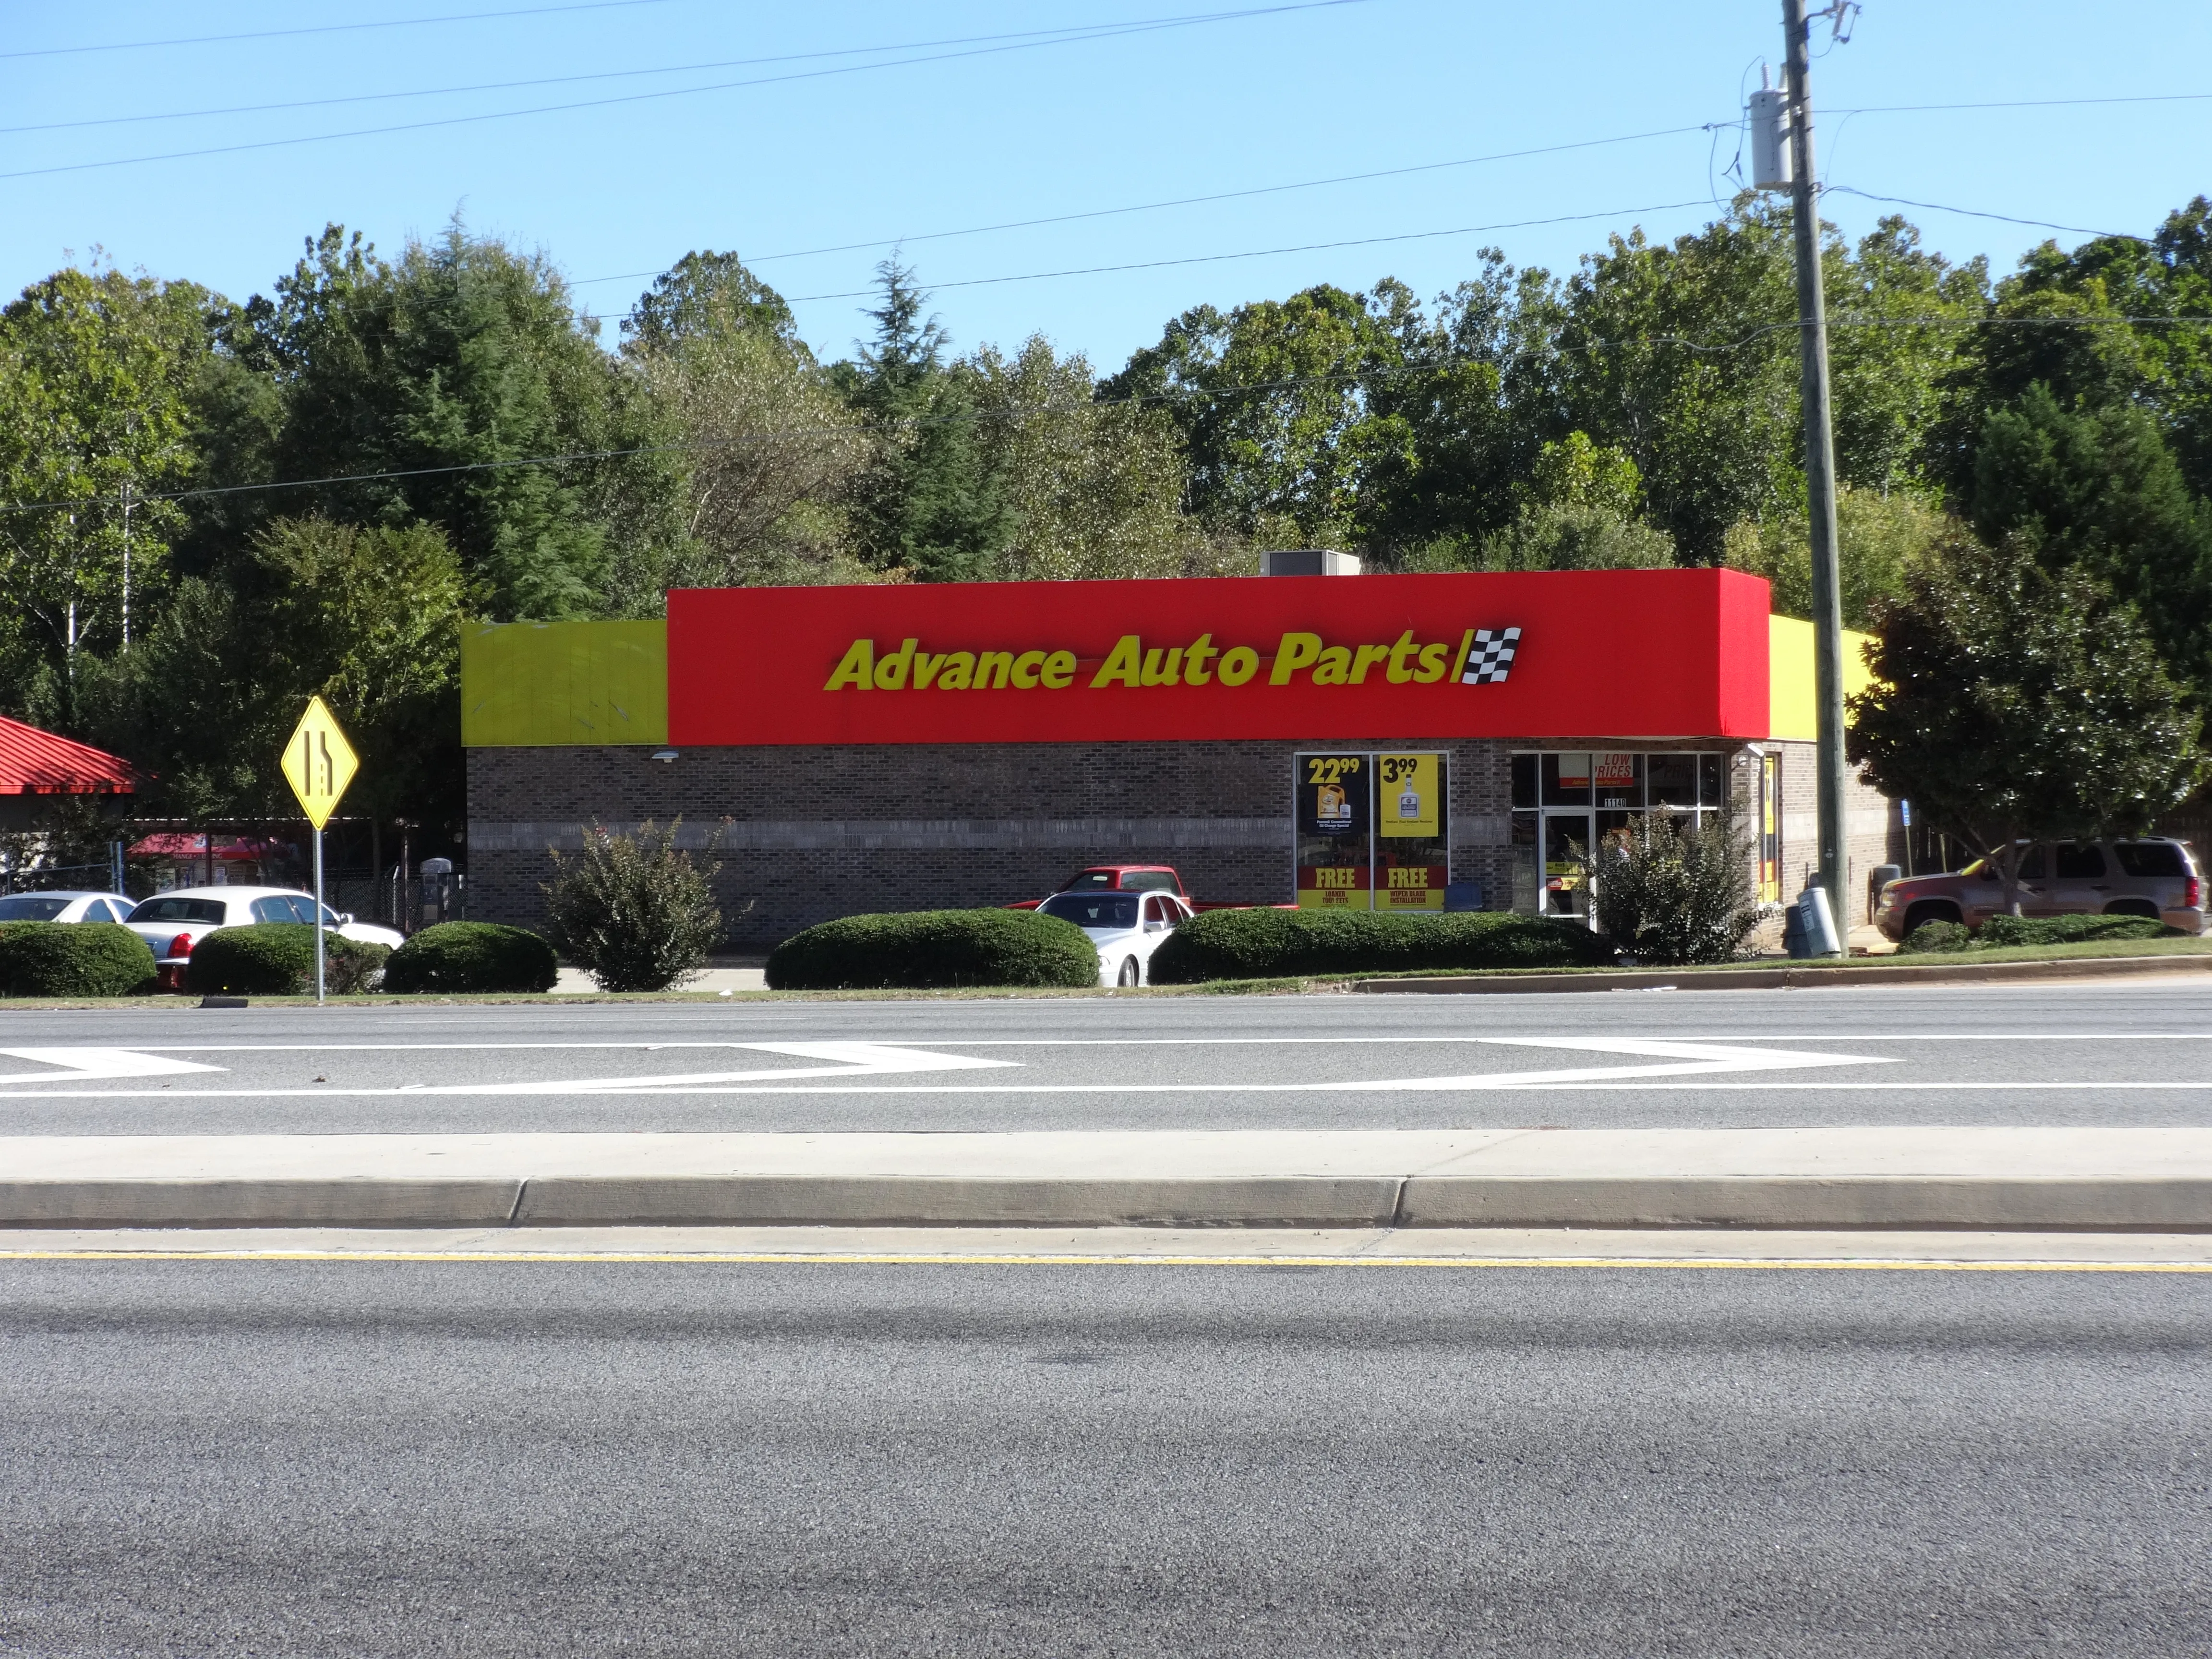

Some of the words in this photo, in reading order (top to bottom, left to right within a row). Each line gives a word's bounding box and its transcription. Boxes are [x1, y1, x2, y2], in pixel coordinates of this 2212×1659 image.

[824, 638, 1076, 690] Advance
[1089, 634, 1259, 687] Auto
[1269, 630, 1448, 685] Parts
[1605, 754, 1630, 765] LOW
[1605, 799, 1626, 807] 11140
[1315, 868, 1355, 888] FREE
[1388, 868, 1428, 888] FREE
